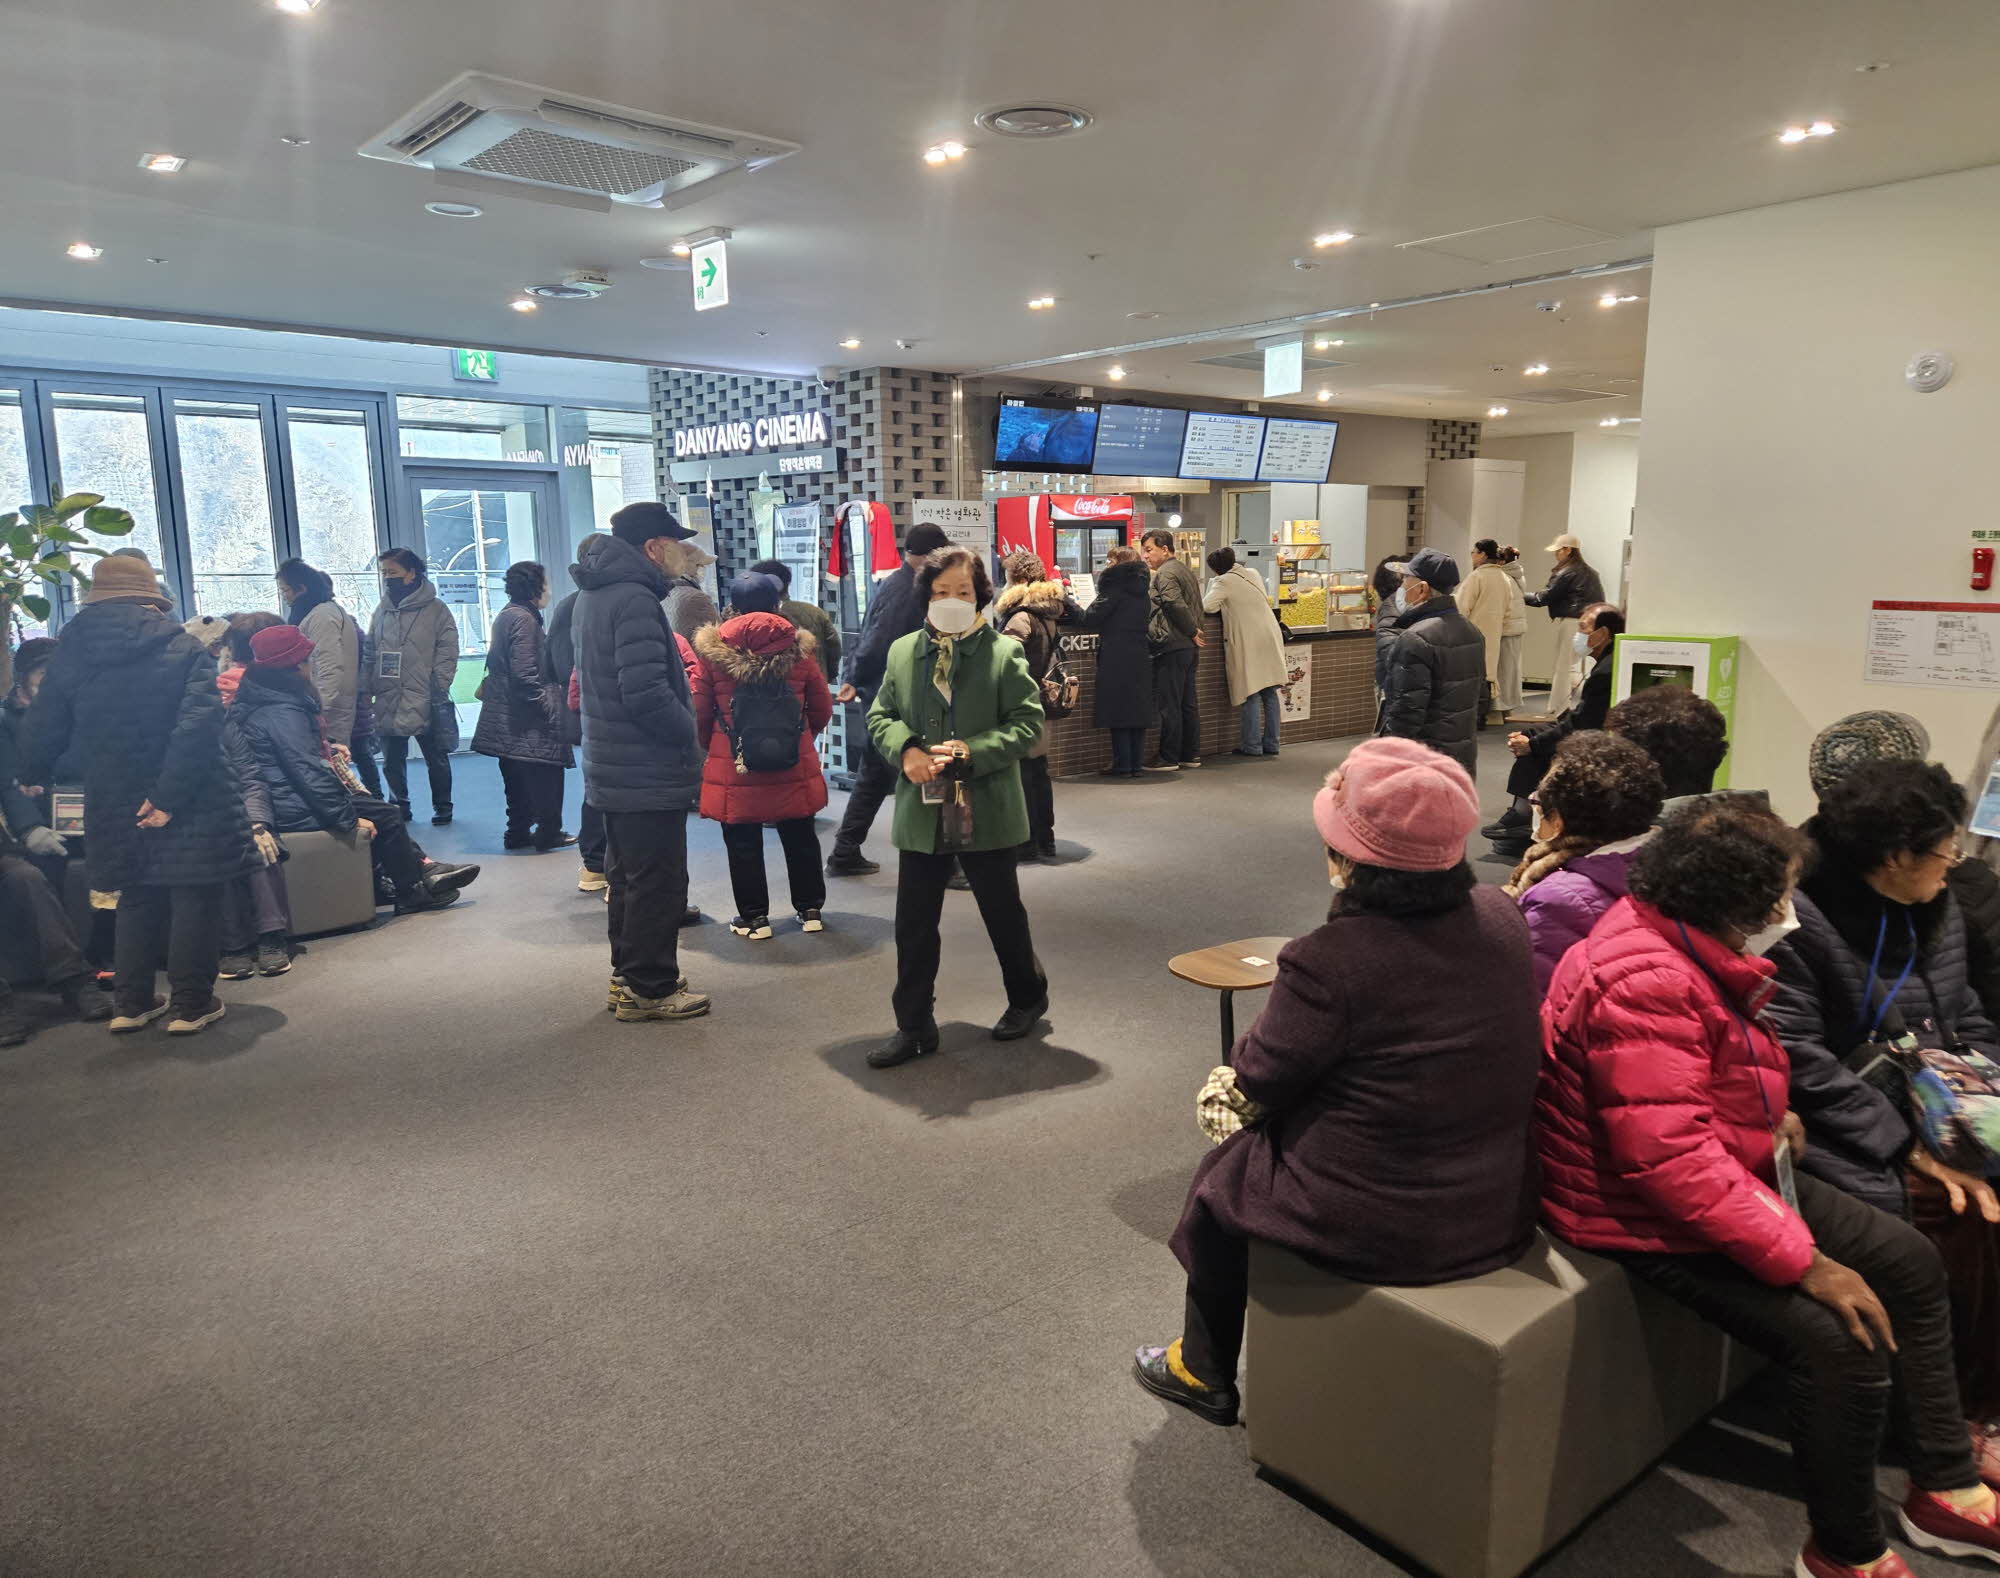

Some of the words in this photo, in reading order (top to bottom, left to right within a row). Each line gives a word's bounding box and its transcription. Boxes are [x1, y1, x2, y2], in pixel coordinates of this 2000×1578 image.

[675, 421, 753, 457] DANYANG
[755, 411, 827, 447] CINEMA
[936, 507, 951, 520] 작은
[954, 506, 982, 521] 영화관
[1074, 497, 1112, 514] Coca-Cola
[944, 530, 971, 538] 요금안내
[1059, 633, 1100, 652] CKET
